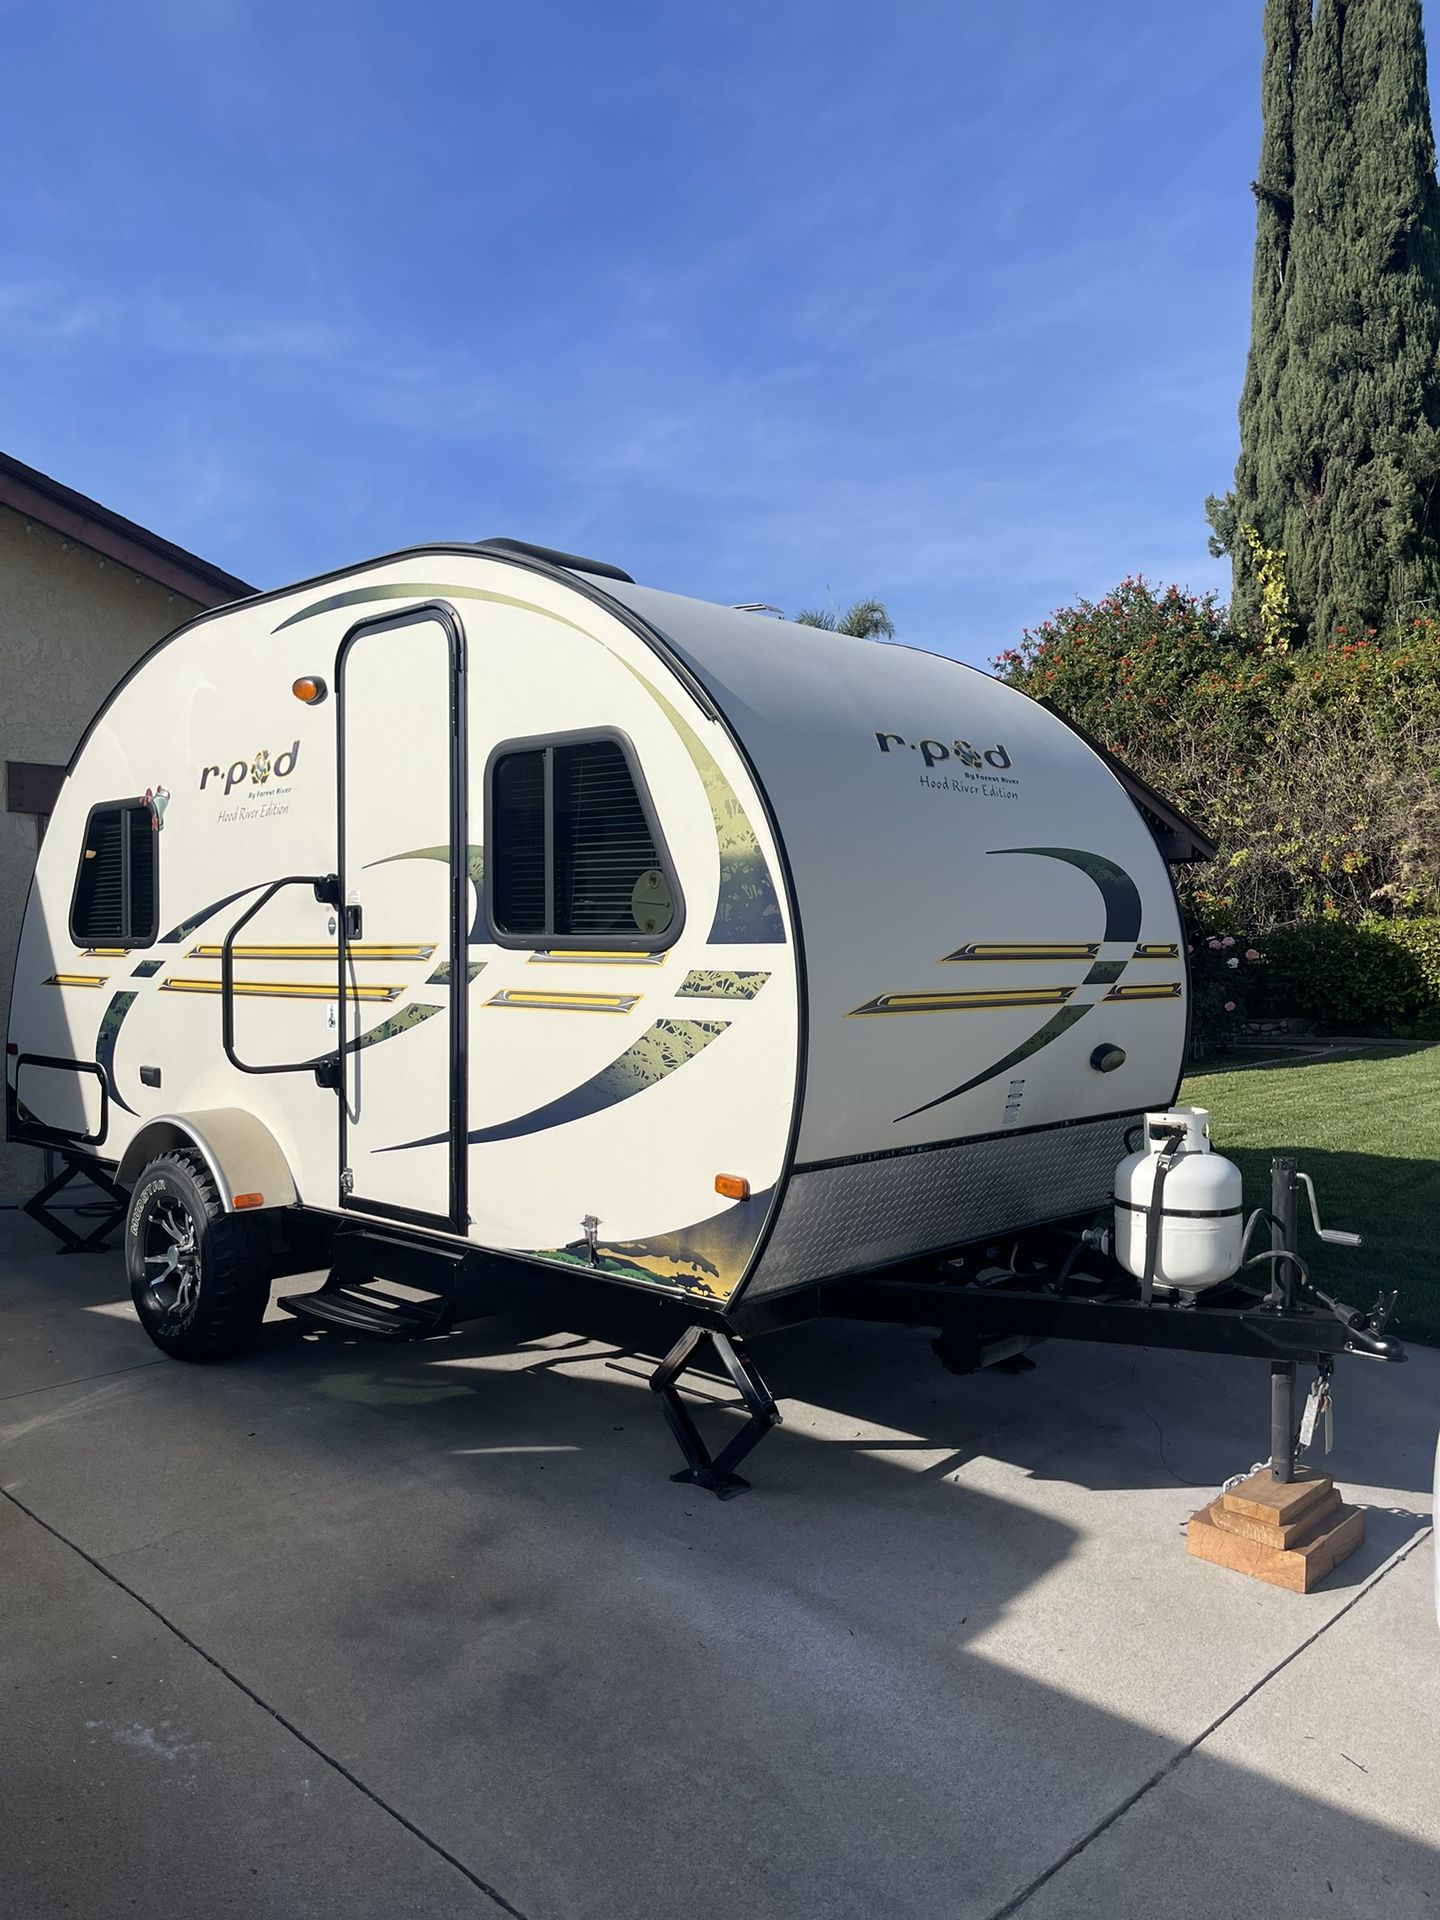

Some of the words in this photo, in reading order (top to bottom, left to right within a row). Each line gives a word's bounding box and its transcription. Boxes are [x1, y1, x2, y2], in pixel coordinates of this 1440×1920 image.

[920, 776, 949, 790] Hood
[952, 780, 979, 794] River
[982, 784, 1019, 799] Edition
[965, 772, 975, 780] By
[976, 774, 999, 782] Forest
[218, 807, 239, 822] Hood
[239, 807, 259, 820] River
[260, 801, 289, 817] Edition
[130, 1179, 166, 1237] MUDSTAR
